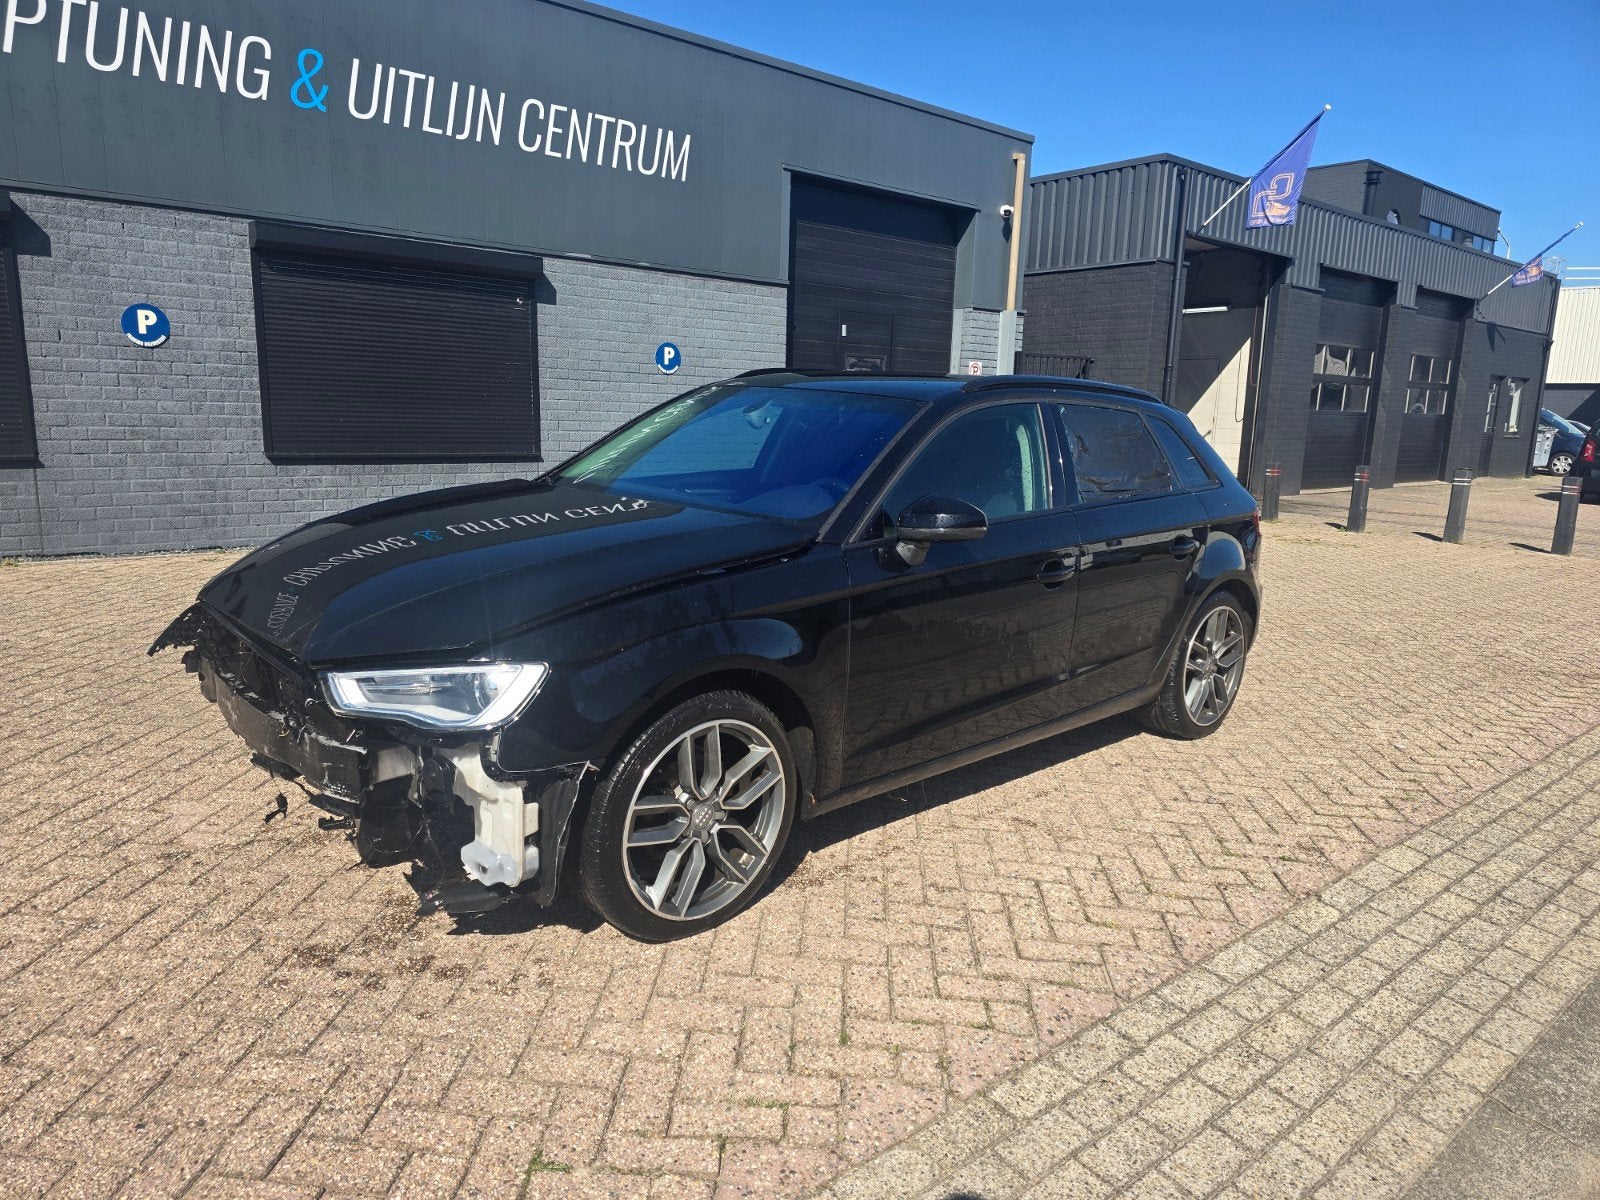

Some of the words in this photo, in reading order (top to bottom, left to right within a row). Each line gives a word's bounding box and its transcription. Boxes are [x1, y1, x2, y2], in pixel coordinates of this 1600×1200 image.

[3, 0, 272, 100] PTUNING
[290, 48, 329, 112] &
[347, 58, 506, 146] UITLIJN
[518, 98, 691, 182] CENTRUM
[137, 309, 157, 334] P
[664, 346, 675, 365] P
